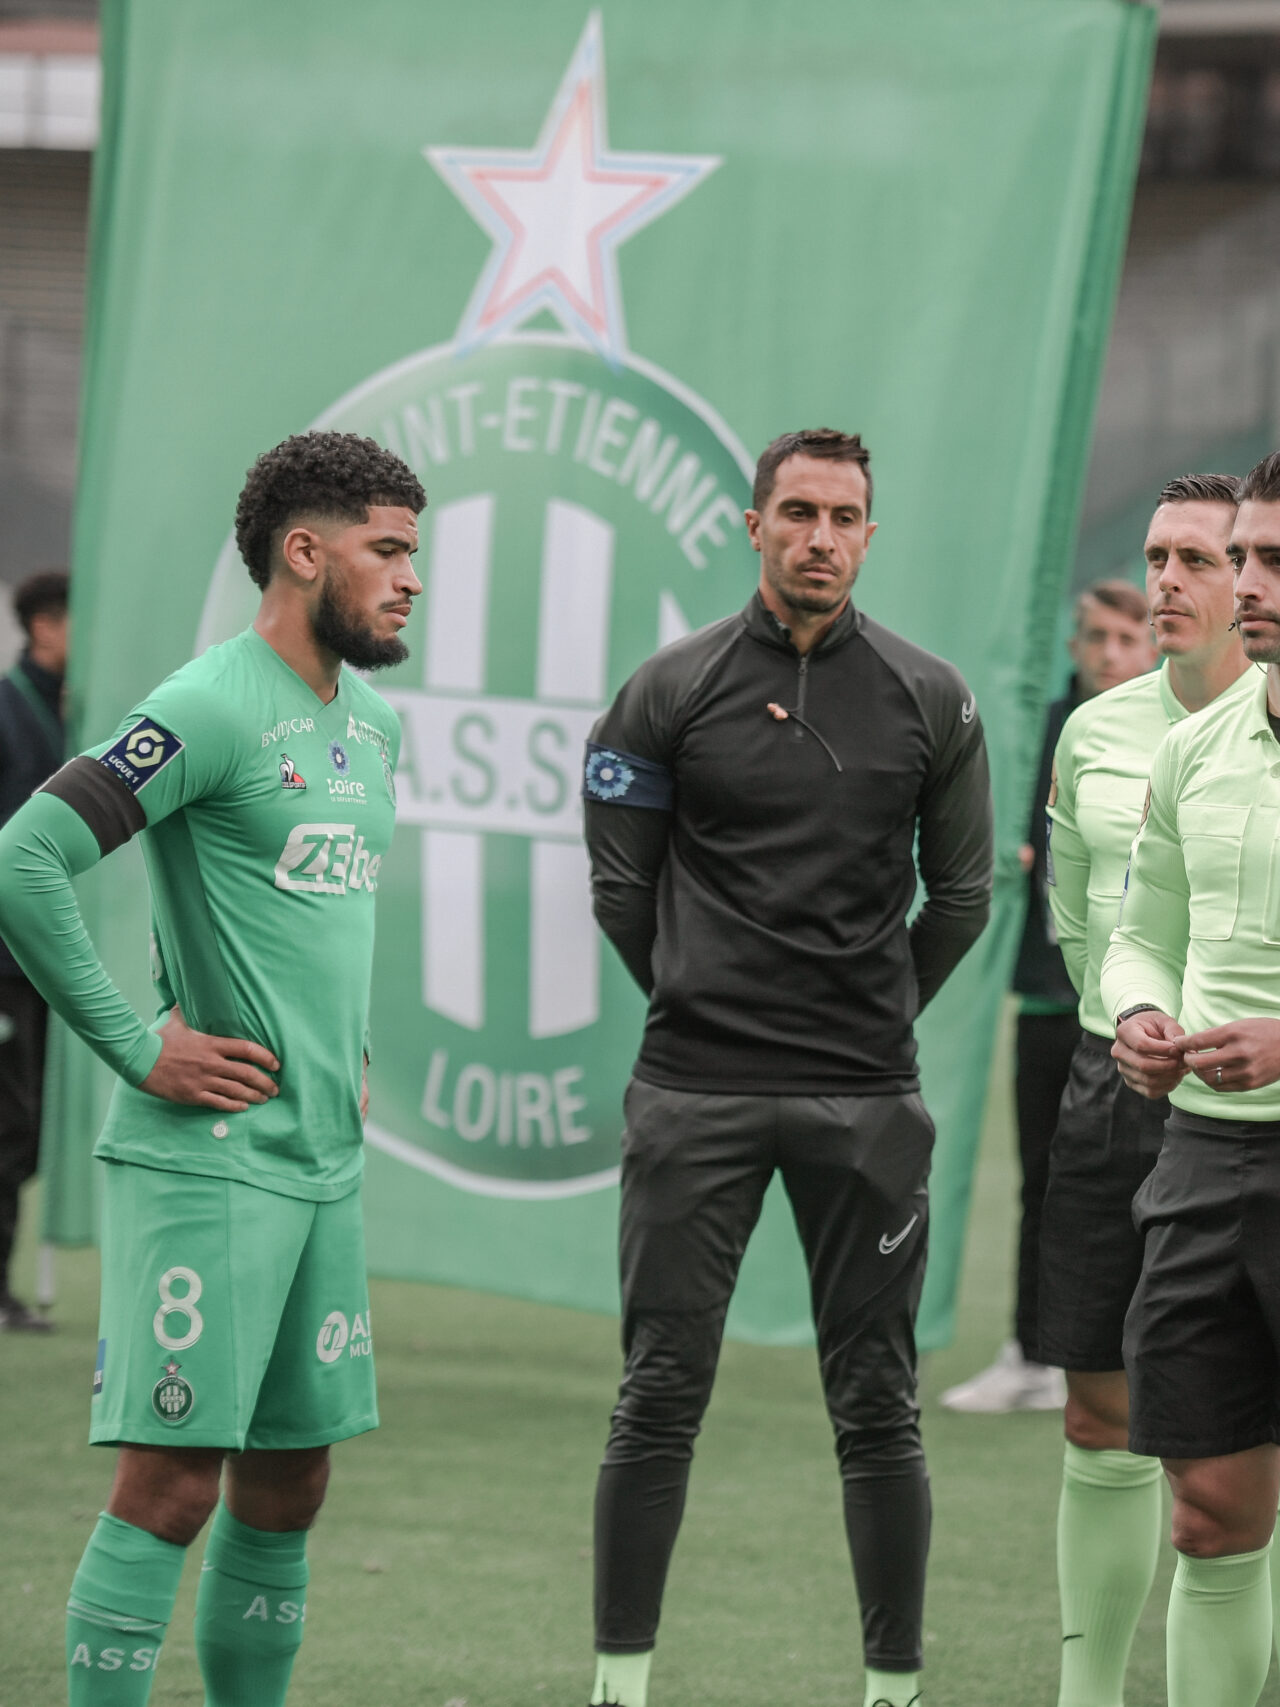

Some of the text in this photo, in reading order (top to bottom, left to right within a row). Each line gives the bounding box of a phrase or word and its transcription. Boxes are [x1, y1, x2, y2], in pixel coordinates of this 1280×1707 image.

[381, 376, 742, 569] INT-ETIENNE
[108, 754, 135, 779] LIGUE
[131, 775, 140, 784] 1
[326, 778, 366, 797] Loire
[274, 822, 382, 895] ZEbe
[420, 1047, 592, 1150] LOIRE
[153, 1266, 203, 1351] 8
